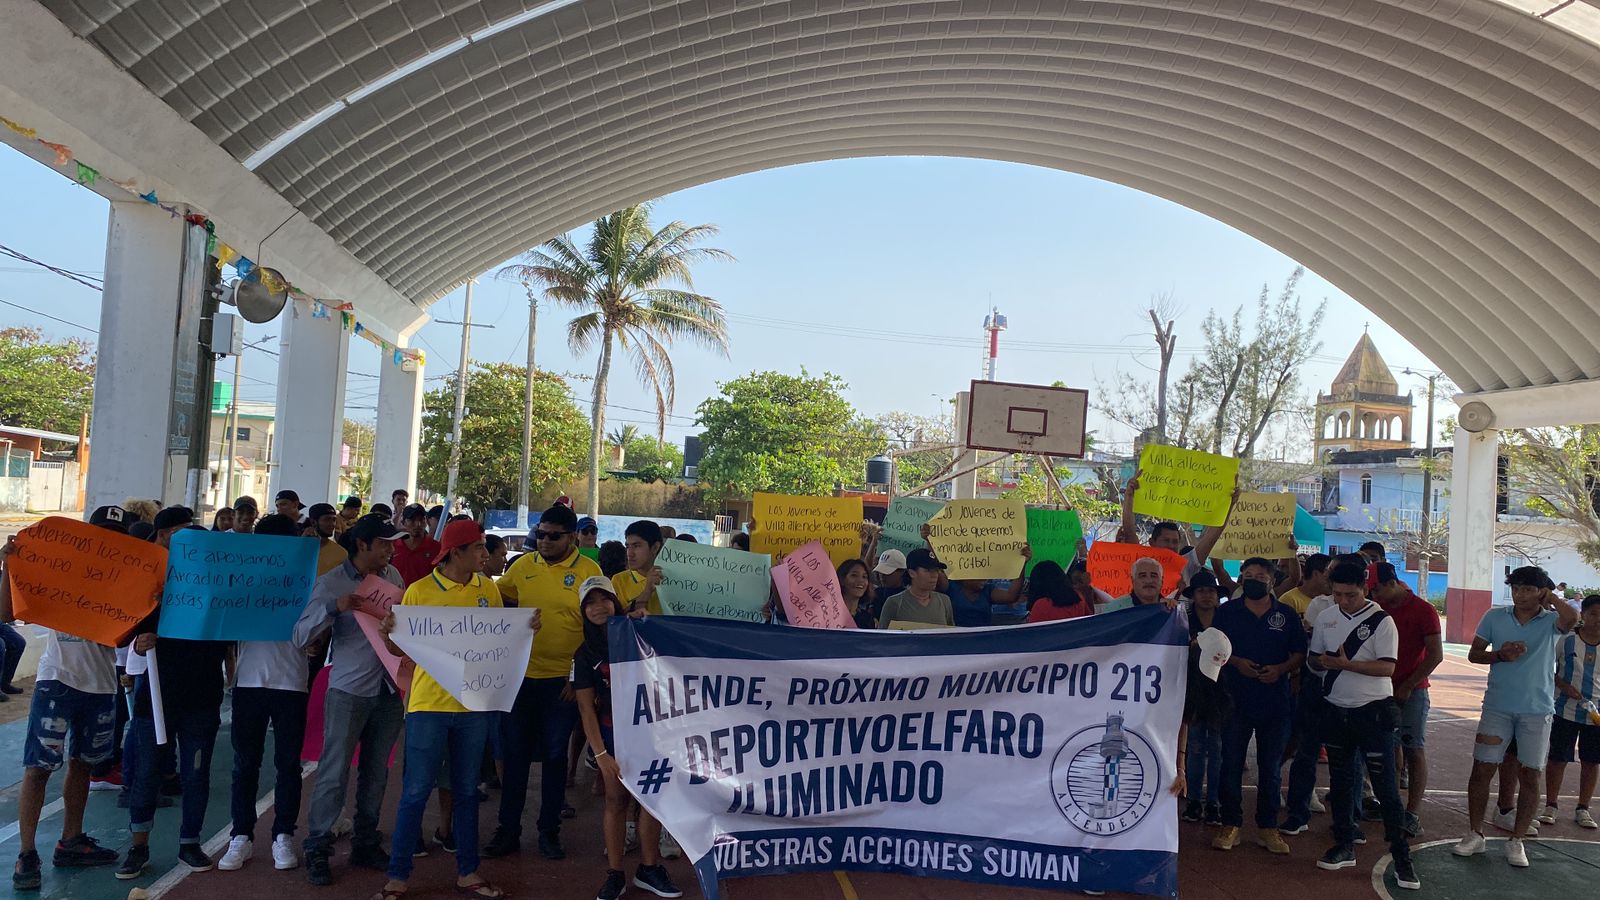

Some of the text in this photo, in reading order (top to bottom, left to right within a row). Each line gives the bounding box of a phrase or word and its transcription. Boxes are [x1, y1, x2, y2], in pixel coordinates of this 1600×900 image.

[1150, 453, 1218, 476] Villa allende
[825, 508, 837, 518] de
[1002, 507, 1016, 520] de
[1272, 502, 1286, 513] de
[764, 520, 786, 532] Villa
[930, 524, 968, 538] allende
[970, 525, 1014, 538] queremos
[176, 542, 286, 568] Te apoyamos
[976, 541, 986, 552] el
[1226, 542, 1238, 554] de
[97, 542, 121, 561] luz
[122, 554, 141, 568] en
[143, 560, 160, 574] el
[722, 558, 739, 574] luz
[740, 564, 754, 574] en
[755, 564, 767, 577] el
[166, 565, 224, 586] Arcadio
[661, 576, 699, 592] ampo
[50, 588, 73, 604] 213
[75, 595, 90, 610] te
[255, 594, 304, 612] deporte
[706, 602, 716, 616] te
[408, 614, 511, 637] Villa allende
[632, 660, 1162, 726] ALLENDE, PRÓXIMO MUNICIPIO 213
[684, 709, 1044, 786] DEPORTIVOELFARO
[727, 760, 944, 818] ILUMINADO
[1056, 791, 1153, 832] ALLENDE 213
[840, 836, 975, 872] ACCIONES
[982, 846, 1080, 884] SUMAN
